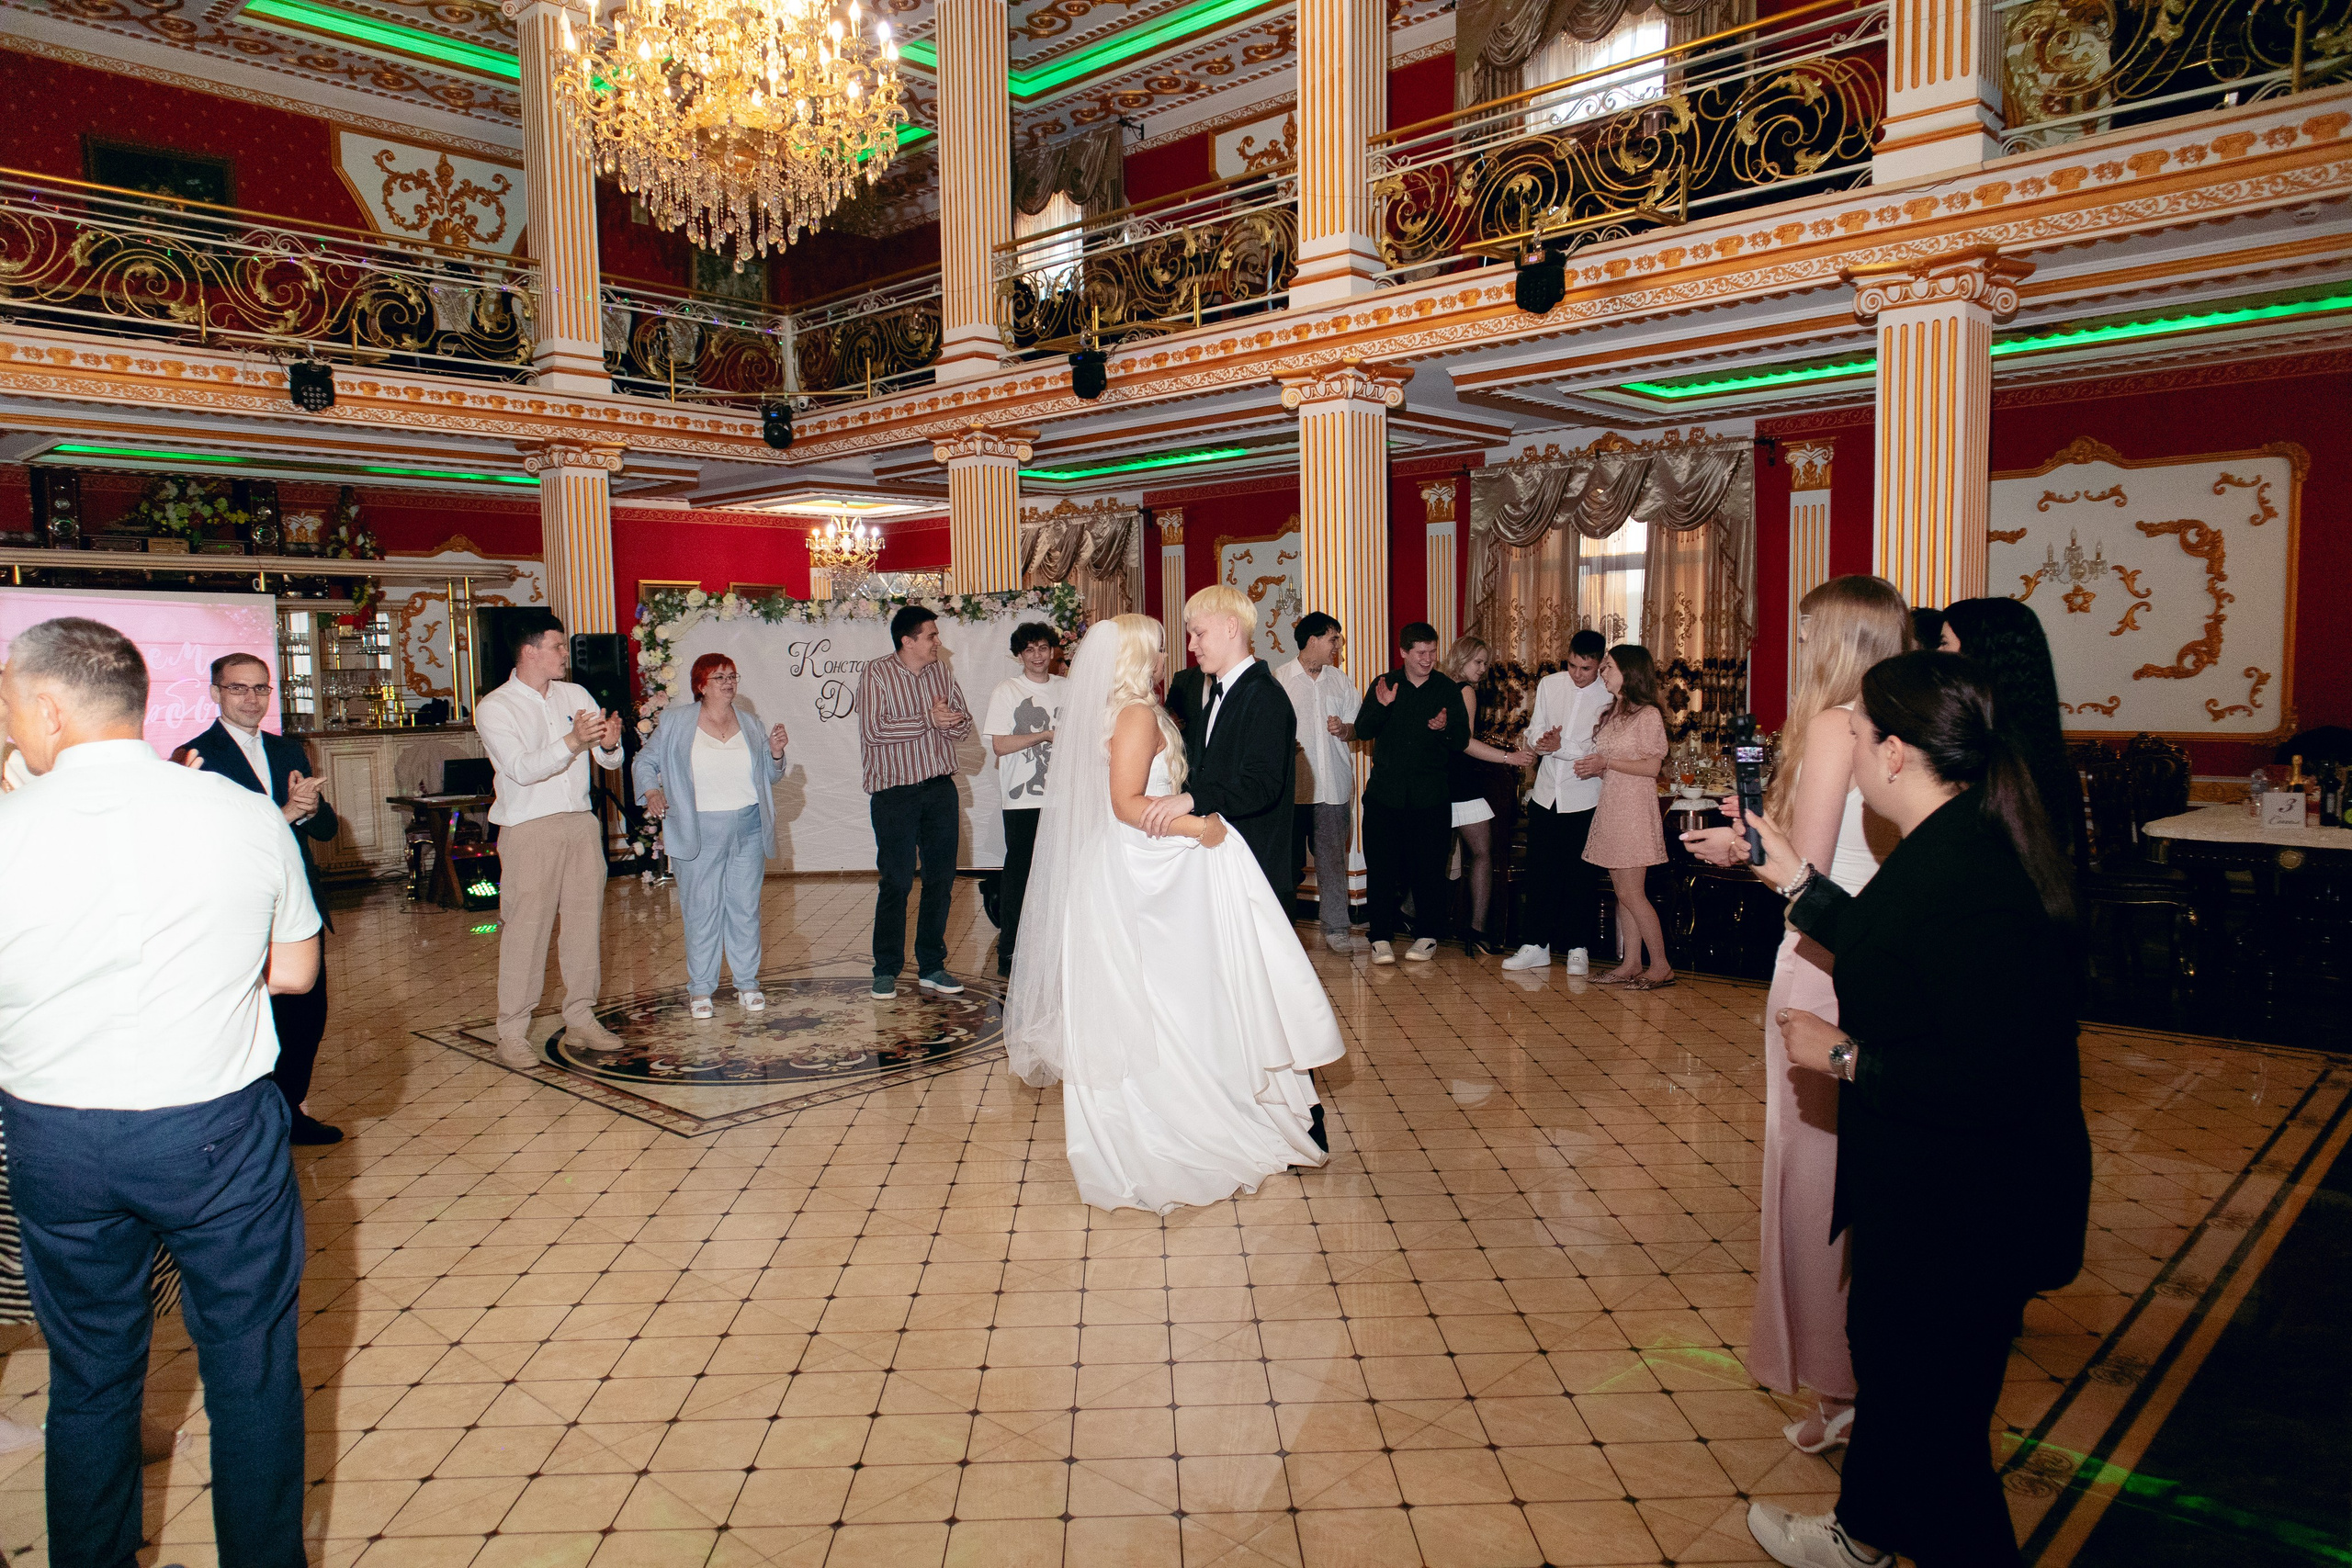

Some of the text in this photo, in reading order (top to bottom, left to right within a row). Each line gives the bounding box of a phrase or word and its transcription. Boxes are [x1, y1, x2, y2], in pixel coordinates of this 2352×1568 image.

[147, 641, 210, 676] ем
[788, 638, 869, 678] Конста
[2278, 798, 2297, 813] 3
